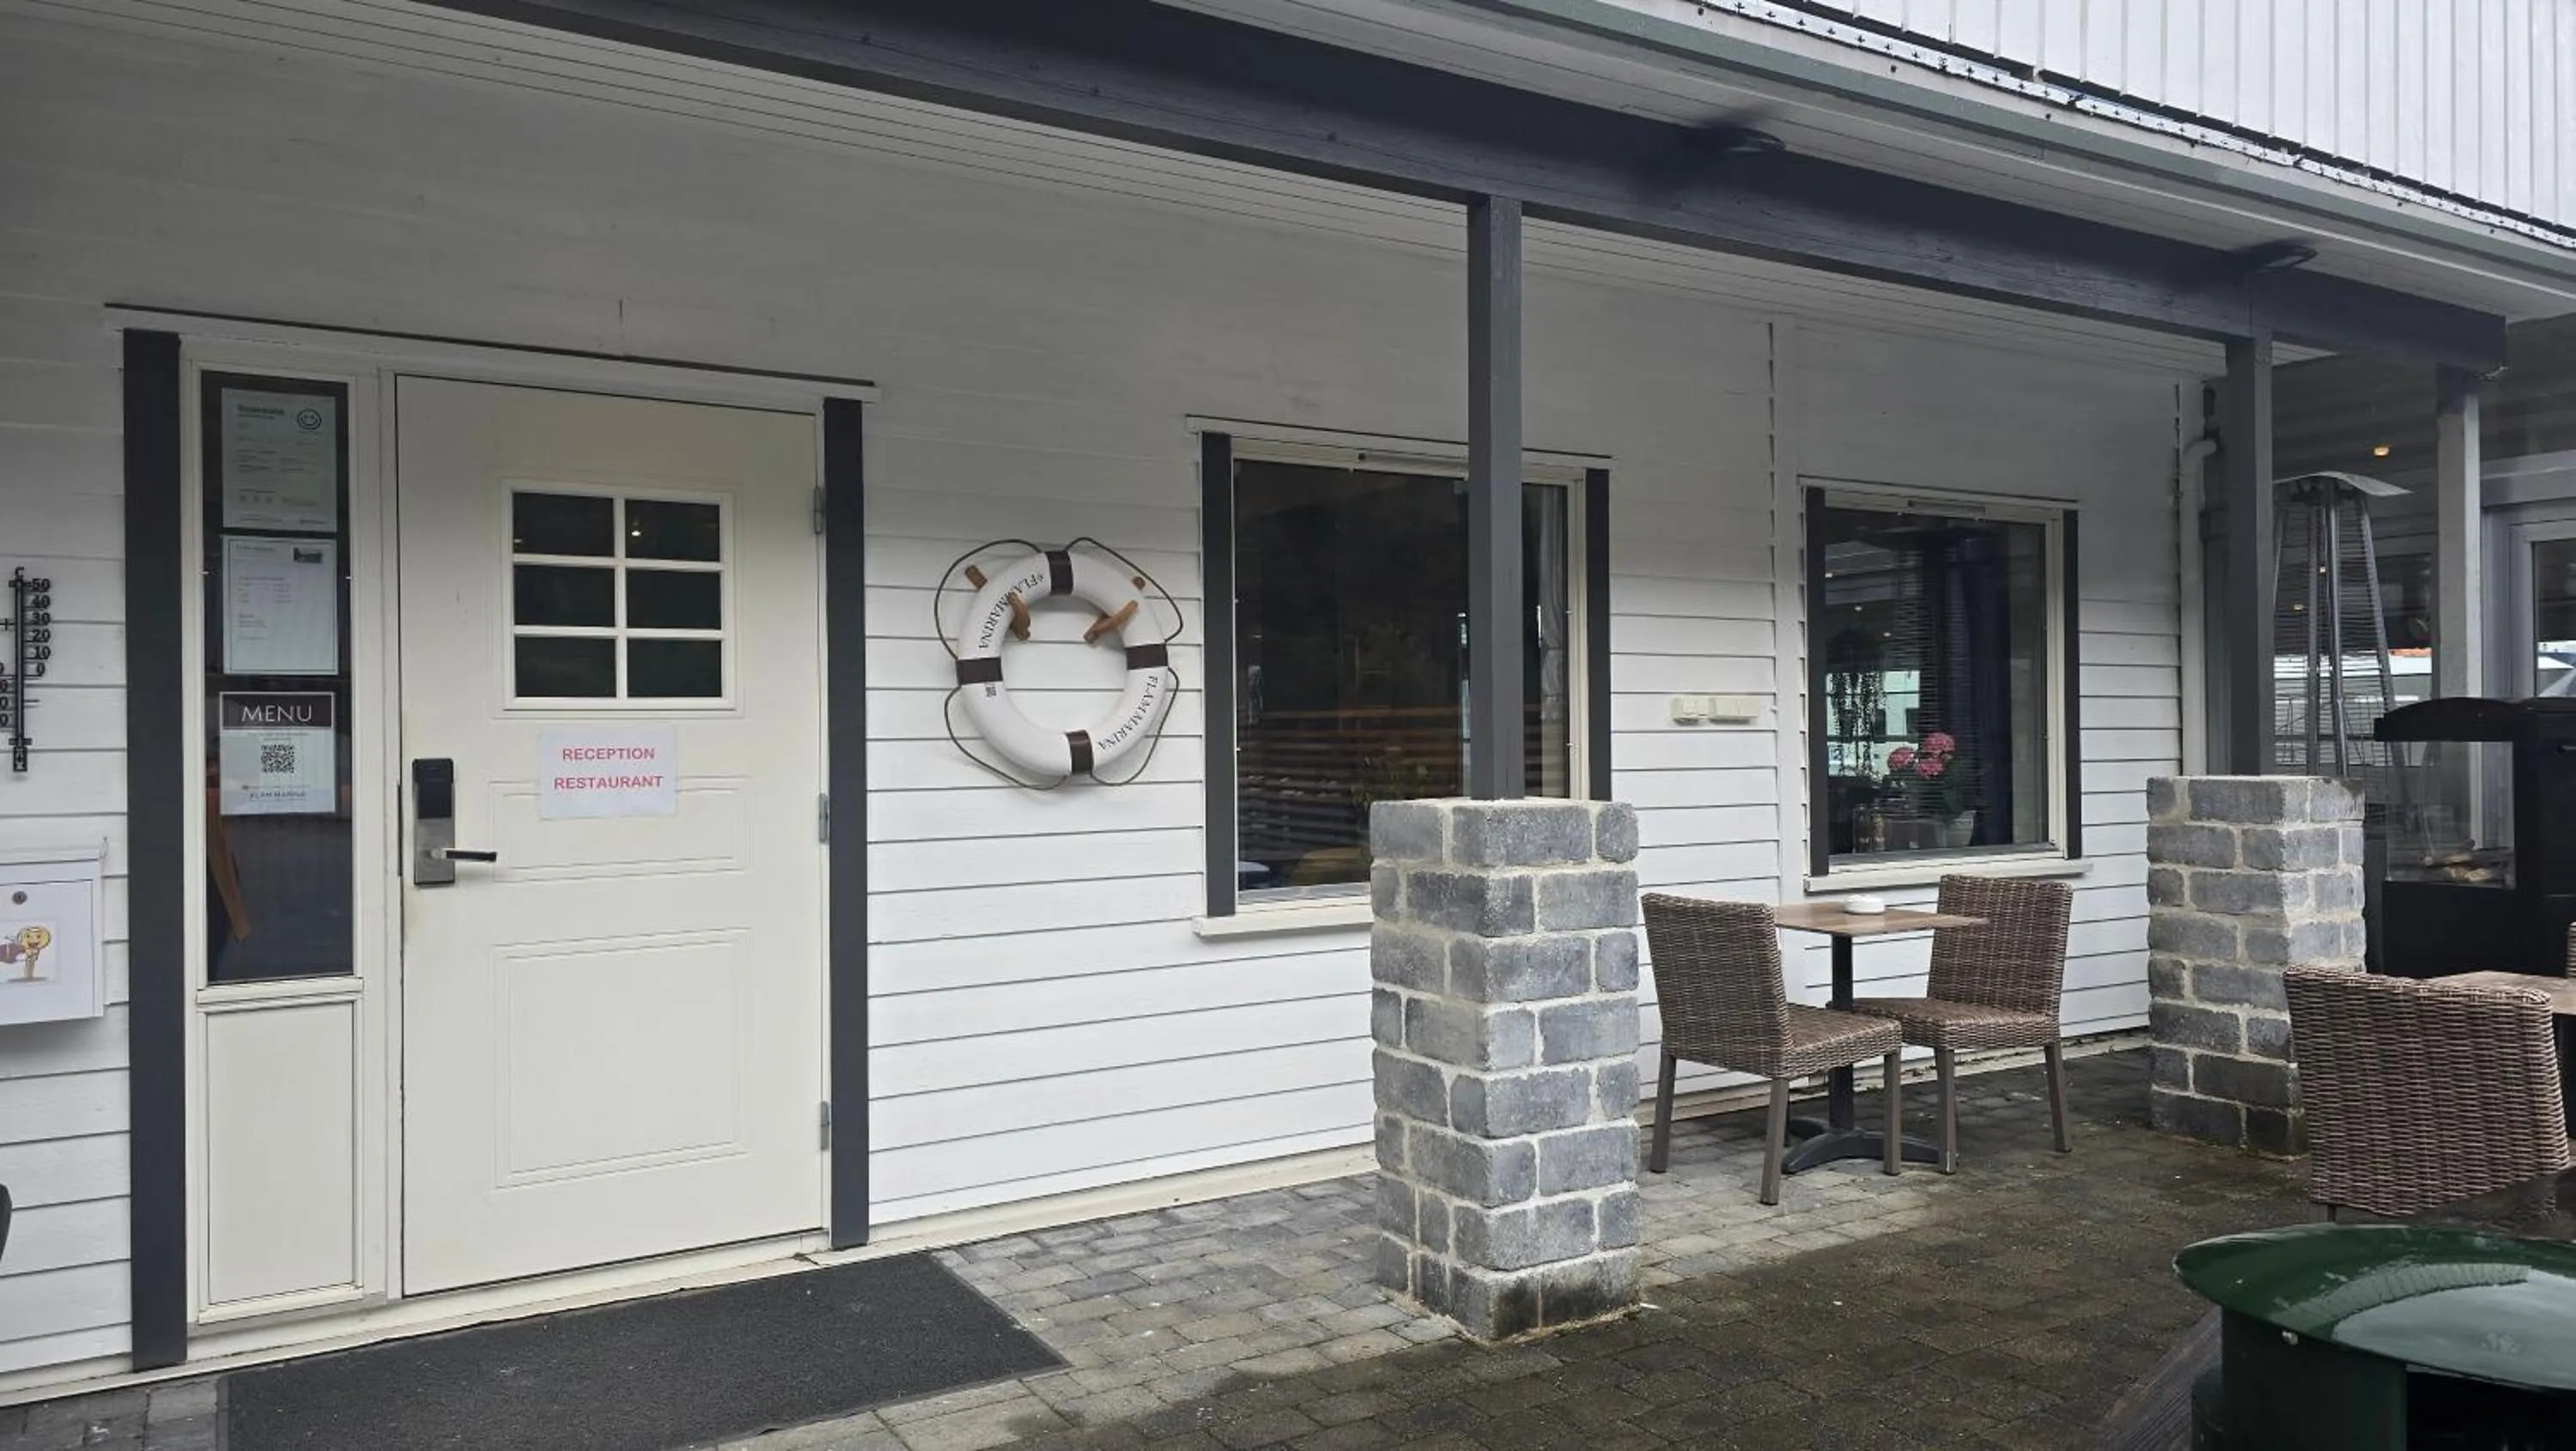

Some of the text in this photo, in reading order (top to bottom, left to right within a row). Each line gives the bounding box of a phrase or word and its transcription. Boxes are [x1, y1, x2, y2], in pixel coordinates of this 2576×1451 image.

[33, 578, 50, 592] 50
[32, 594, 51, 609] 40
[33, 612, 51, 626] 30
[33, 628, 51, 643] 20
[34, 645, 52, 659] 10
[36, 662, 46, 677] 0
[241, 704, 313, 723] MENU
[562, 747, 656, 762] RECEPTION
[553, 775, 665, 792] RESTAURANT
